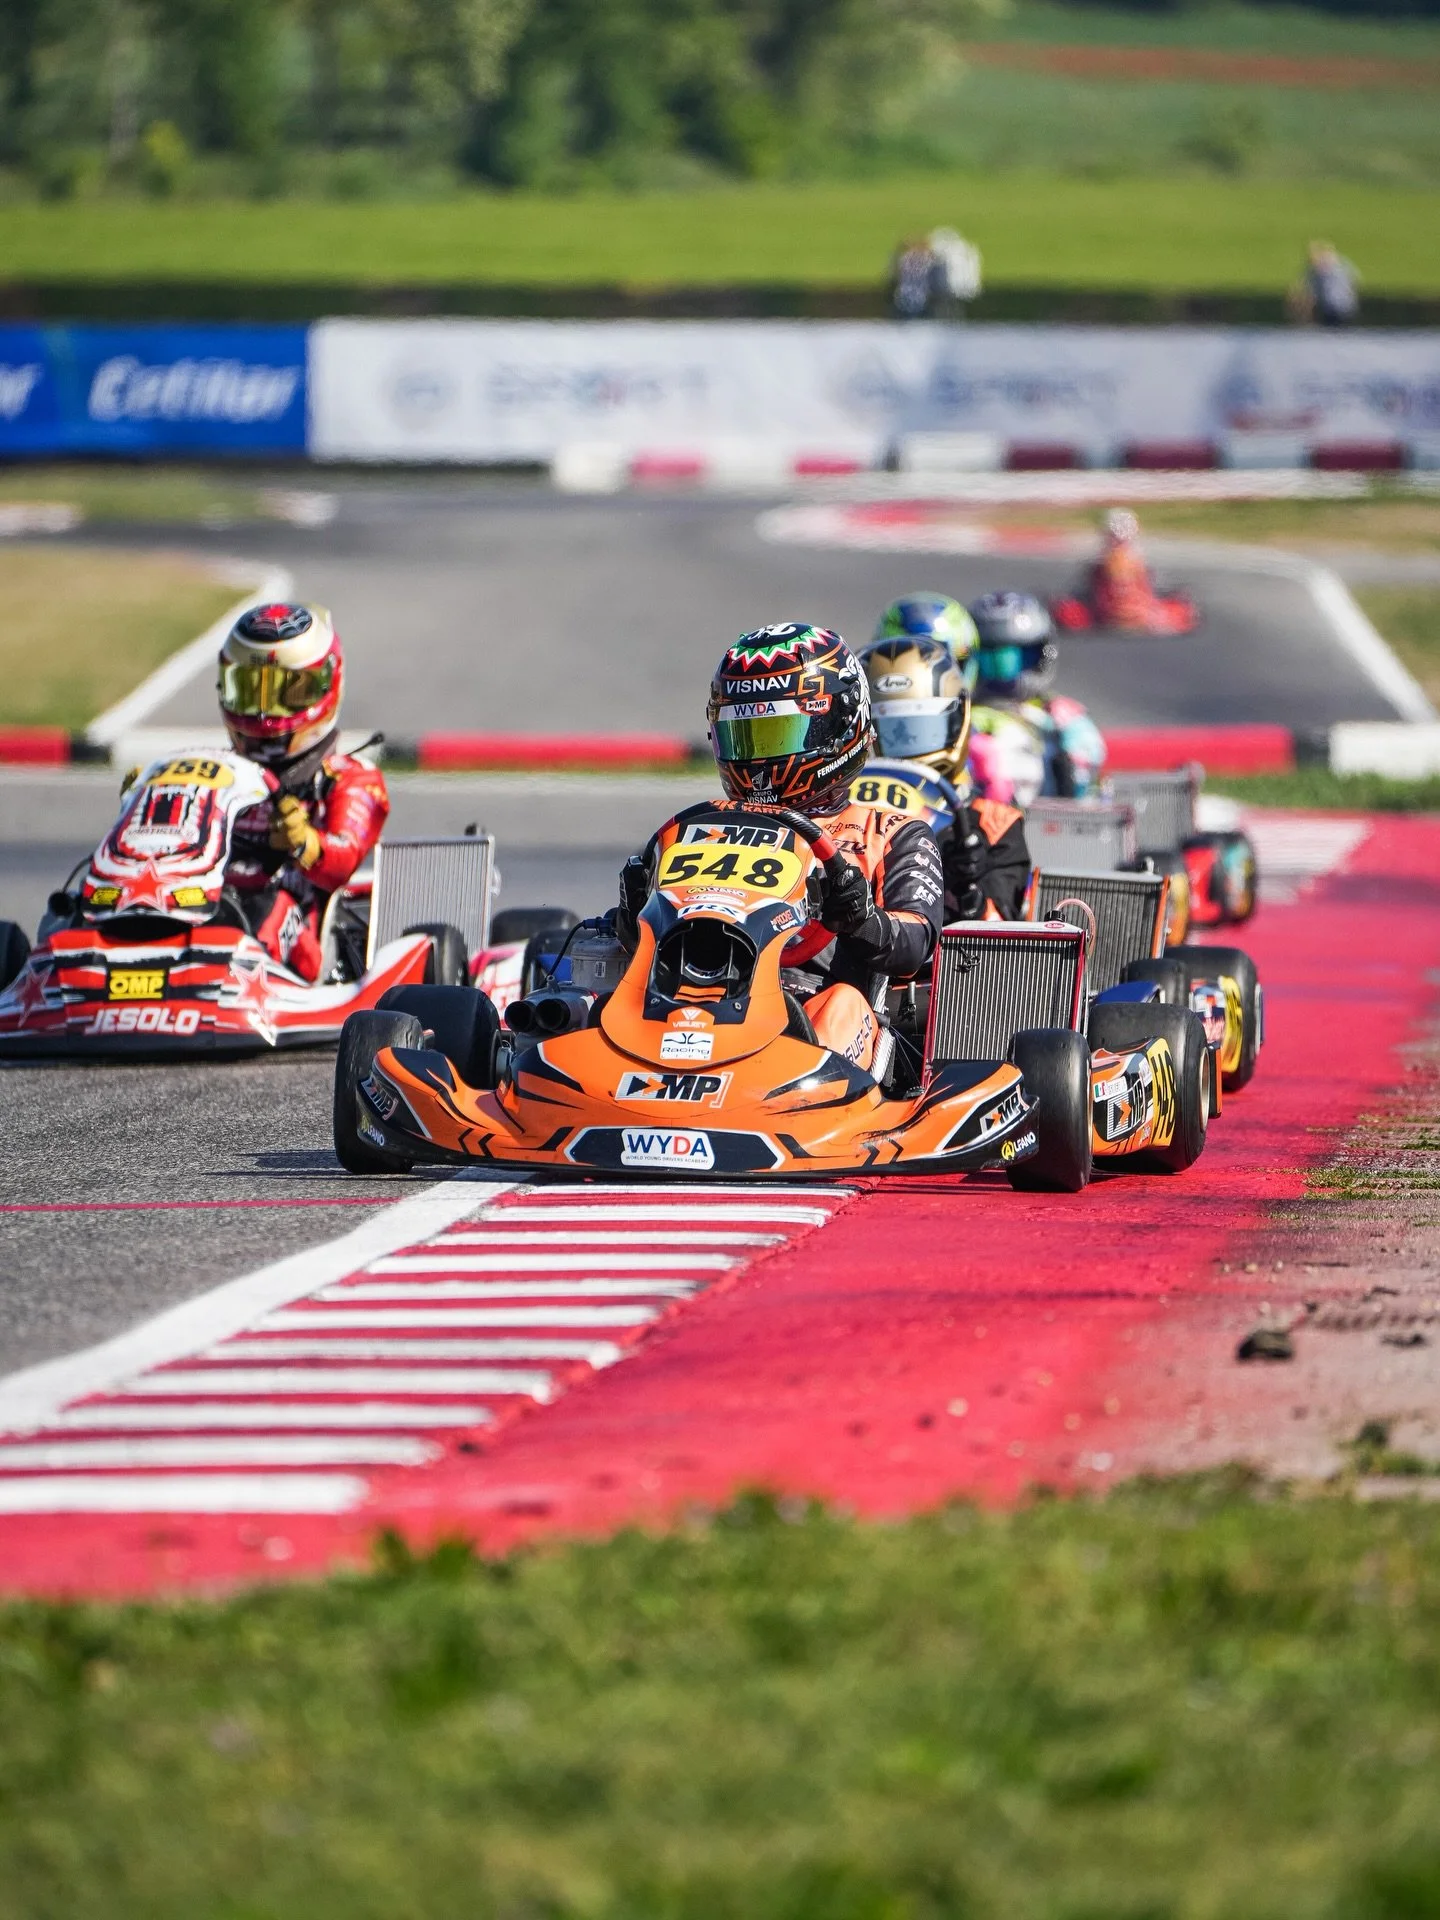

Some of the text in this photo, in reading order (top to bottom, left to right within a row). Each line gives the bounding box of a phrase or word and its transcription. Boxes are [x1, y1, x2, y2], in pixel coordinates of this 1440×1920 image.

[726, 674, 792, 694] VISNAV
[734, 702, 776, 716] WYDA
[817, 753, 848, 779] FERNANDO
[746, 794, 778, 804] VISNAV
[752, 790, 772, 798] GRUPO
[660, 853, 784, 888] 548
[109, 975, 164, 995] OMP
[84, 1007, 201, 1036] JESOLO
[662, 1046, 710, 1055] Racing
[627, 1133, 708, 1157] WYDA
[1002, 1131, 1036, 1160] ALFANO
